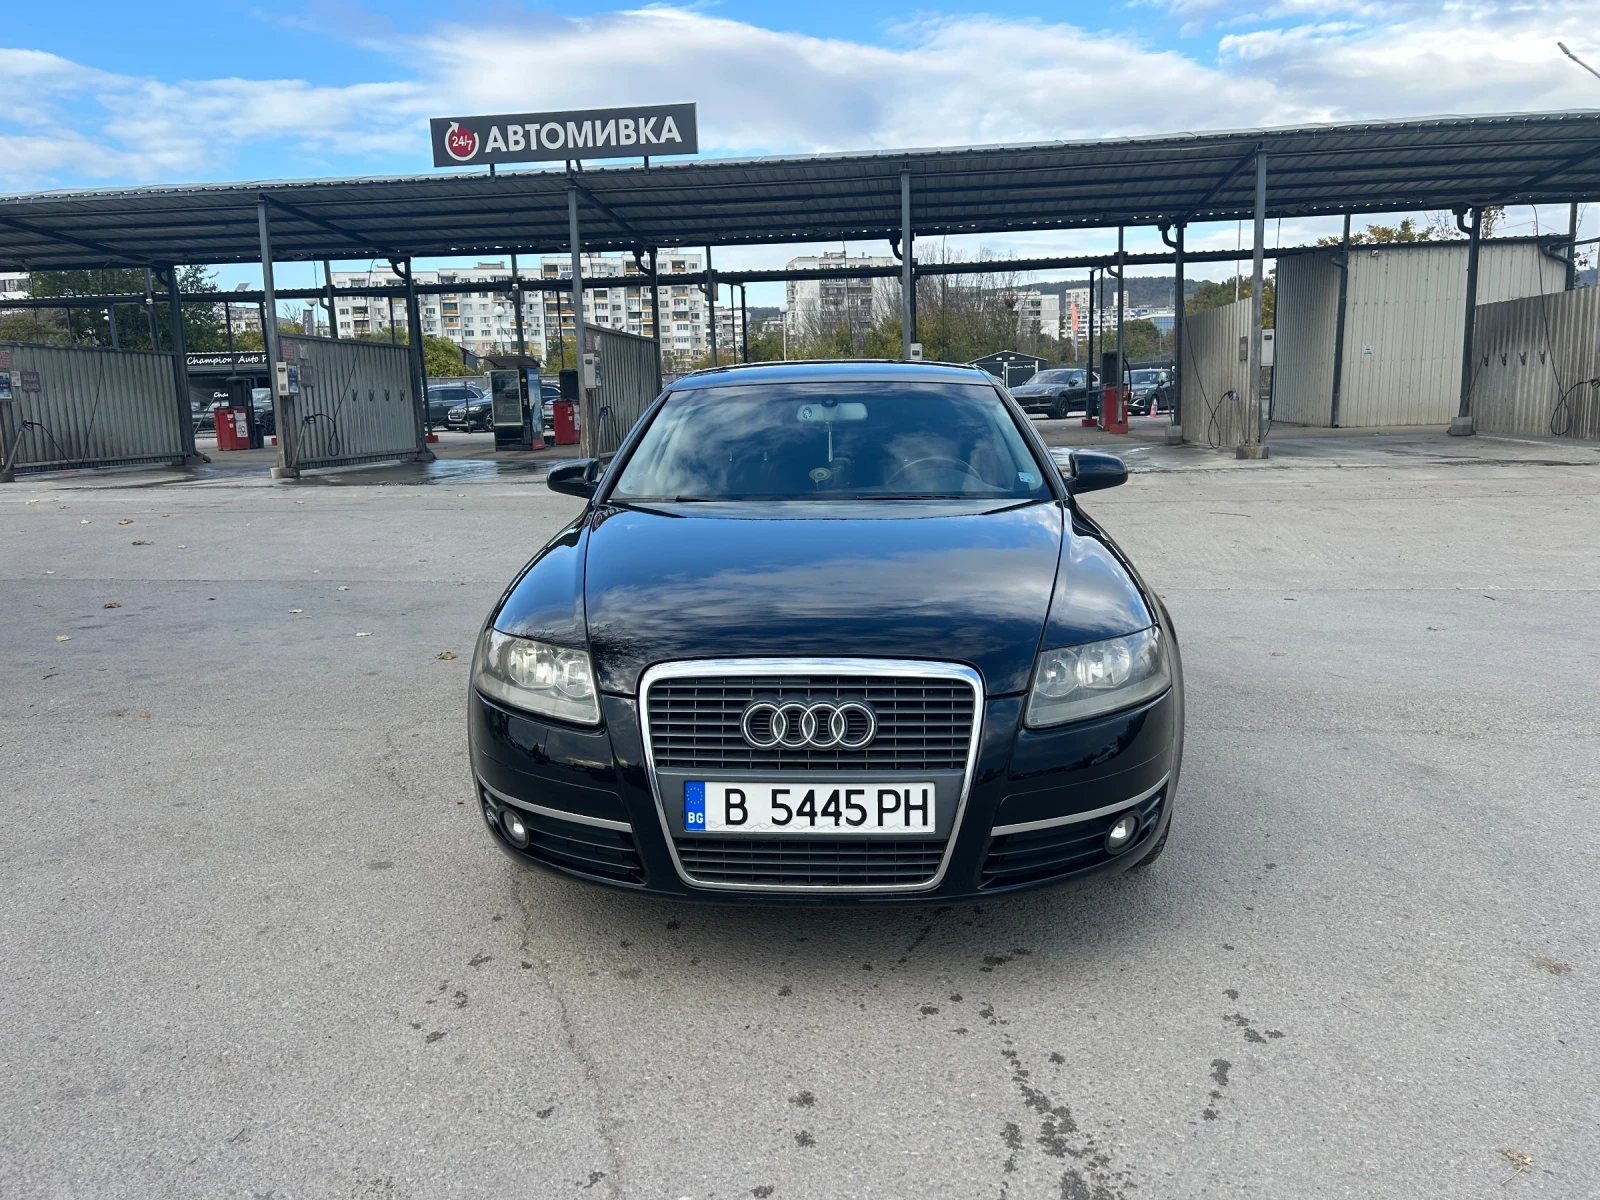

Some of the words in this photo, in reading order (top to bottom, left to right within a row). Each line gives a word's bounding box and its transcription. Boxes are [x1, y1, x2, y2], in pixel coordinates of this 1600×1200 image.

[485, 116, 682, 153] АВТОМИВКА
[452, 135, 473, 151] 24/7
[187, 356, 233, 366] Champion
[238, 354, 259, 364] Auto
[687, 812, 704, 824] BG
